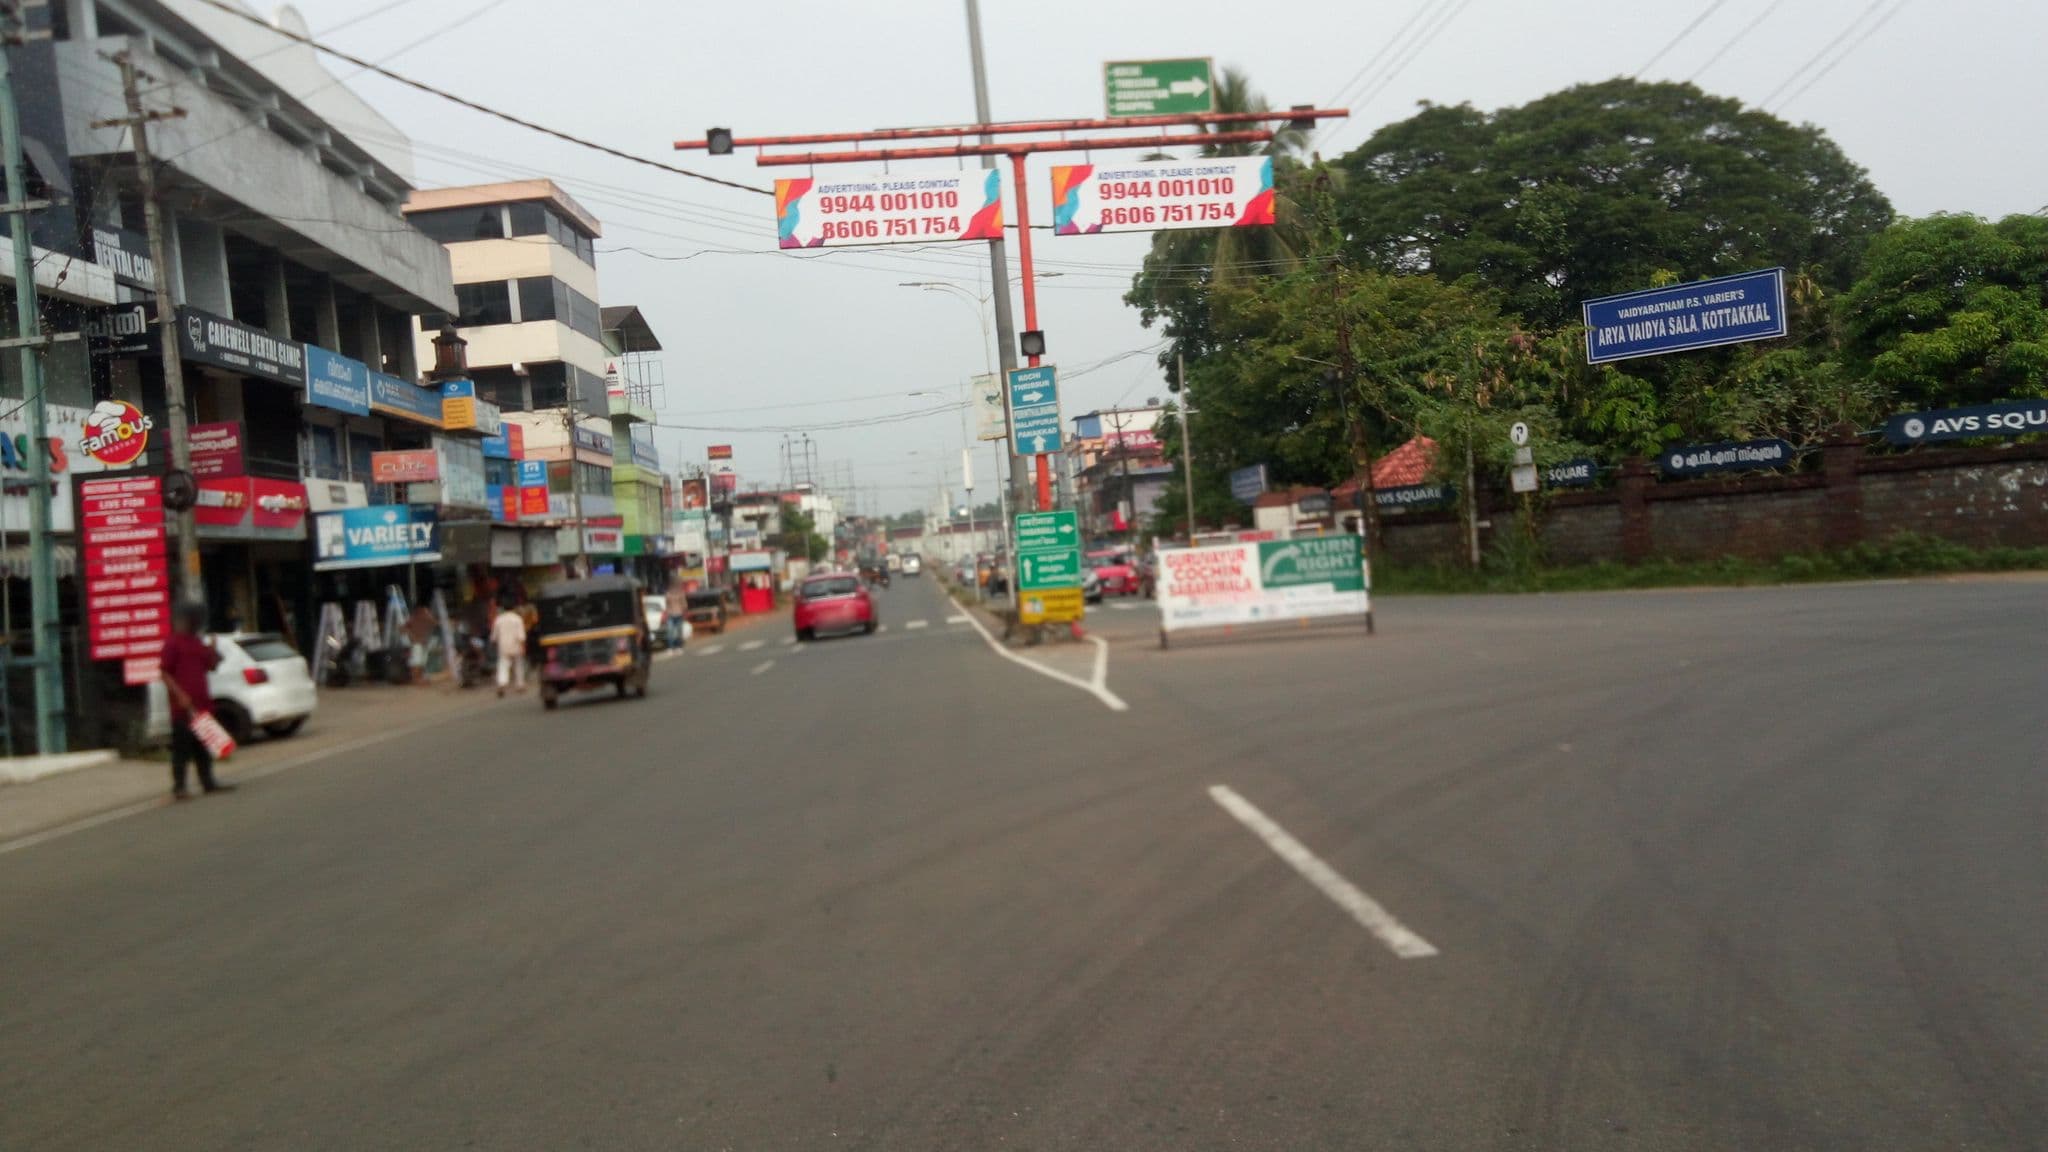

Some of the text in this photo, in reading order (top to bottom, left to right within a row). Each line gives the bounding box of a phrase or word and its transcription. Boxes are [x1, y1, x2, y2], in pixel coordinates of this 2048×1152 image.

[1159, 167, 1193, 177] PLEASE
[1196, 165, 1236, 176] CONTACT
[882, 180, 917, 191] PLEASE
[918, 178, 960, 189] CONTACT
[1099, 177, 1234, 200] 9944 001010
[820, 190, 958, 214] 9944 001010
[1101, 201, 1236, 225] 8606 751 754
[822, 215, 961, 240] 8606 751 754
[1618, 289, 1745, 320] VAIDYARATNAM P.S. VARIER'S
[1599, 325, 1626, 347] ARYA
[1627, 320, 1667, 342] VAIDYA
[1701, 302, 1771, 331] KOTTAKKAL
[207, 321, 251, 354] CAREWELL
[251, 331, 278, 362] DENTAL
[278, 341, 302, 369] CLINIC
[1018, 372, 1041, 381] KOCHI
[1931, 409, 2048, 434] AVS SQU
[1549, 464, 1590, 482] SQUARE
[347, 521, 433, 546] VARIETY
[1303, 538, 1356, 554] TURN
[1297, 552, 1356, 571] RIGHT
[1173, 565, 1243, 582] COCHIN
